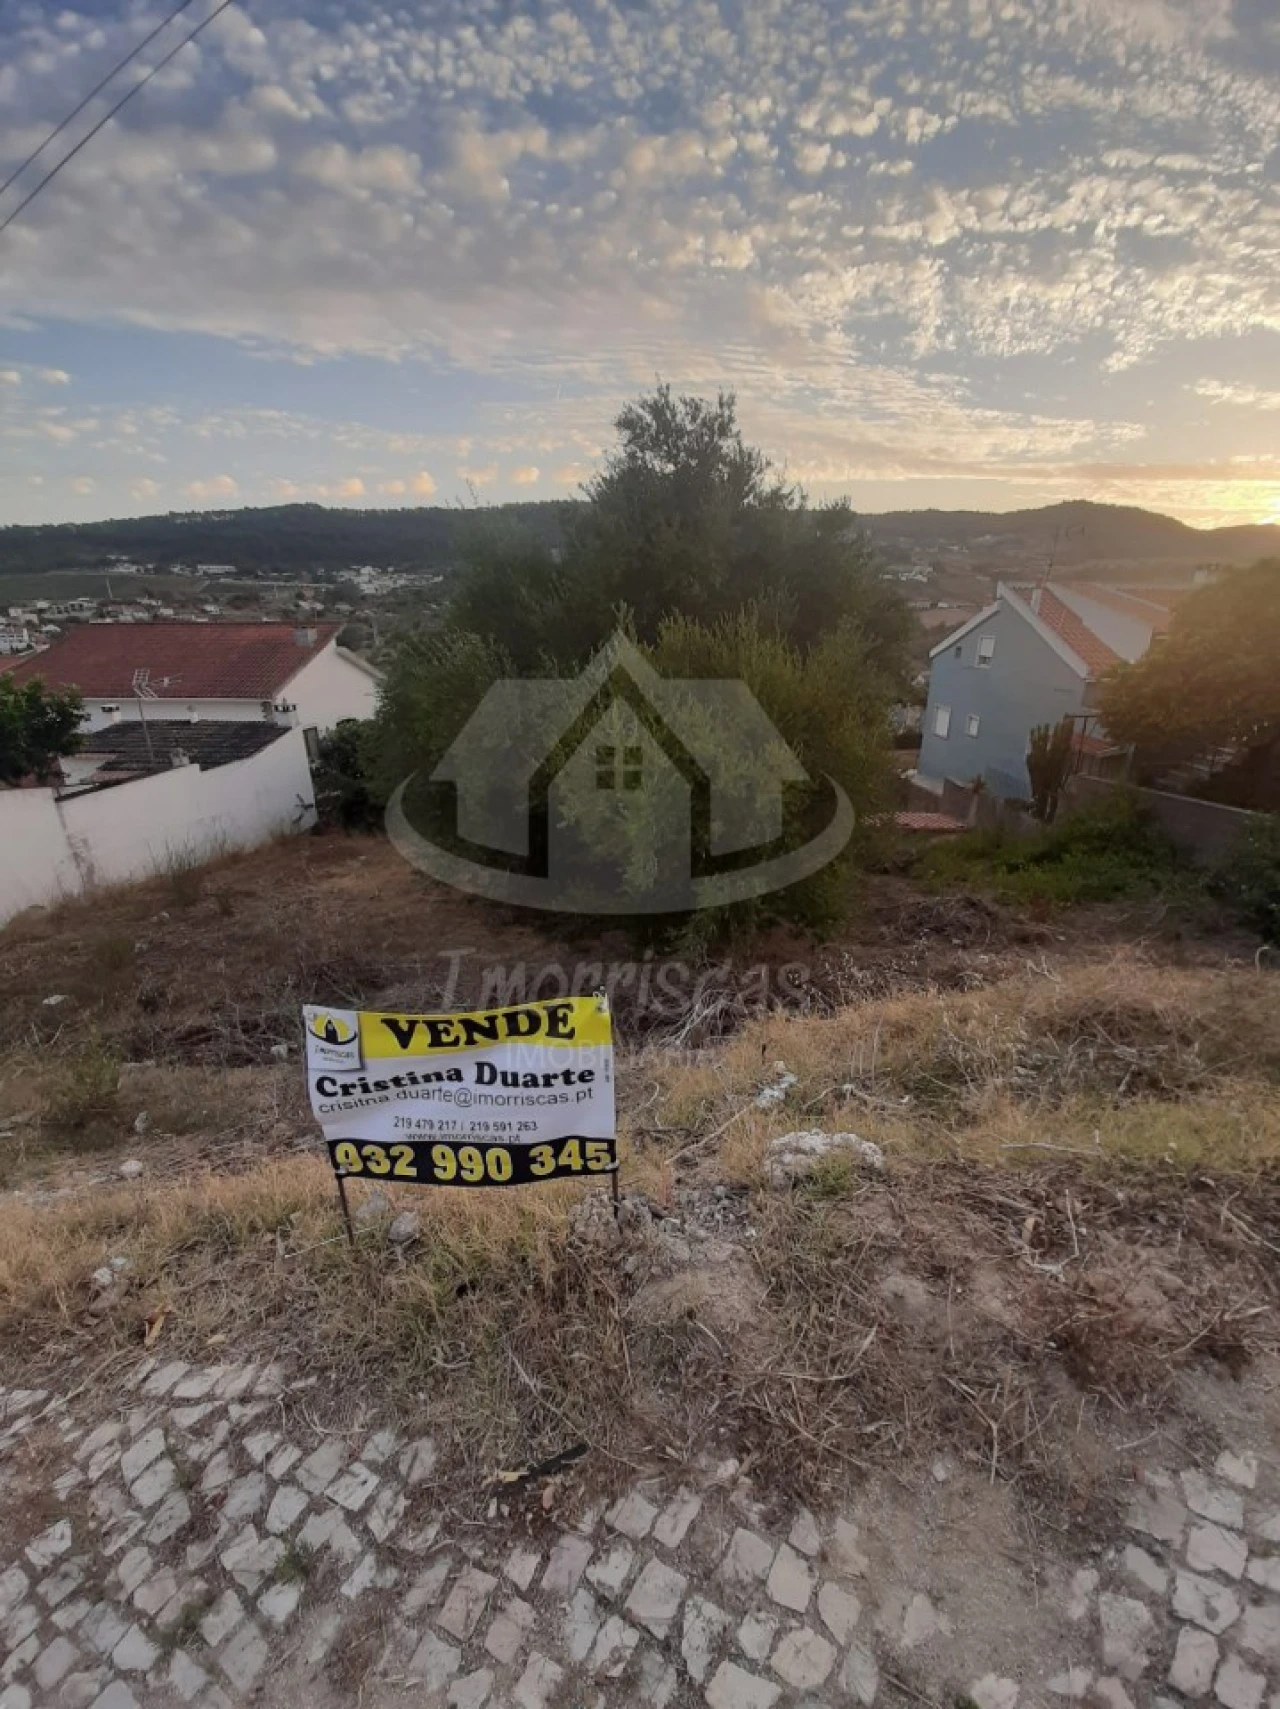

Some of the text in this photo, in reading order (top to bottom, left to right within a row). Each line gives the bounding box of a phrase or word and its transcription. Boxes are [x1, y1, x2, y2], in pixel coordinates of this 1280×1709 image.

[381, 1004, 576, 1049] VENDE
[316, 1068, 464, 1097] Cristina
[475, 1061, 595, 1089] Duarte
[393, 1115, 413, 1129] 219
[415, 1117, 435, 1131] 479
[438, 1119, 457, 1131] 217
[470, 1120, 490, 1131] 219
[493, 1120, 512, 1132] 591
[516, 1120, 539, 1132] 263
[335, 1139, 611, 1181] 932 990 345
